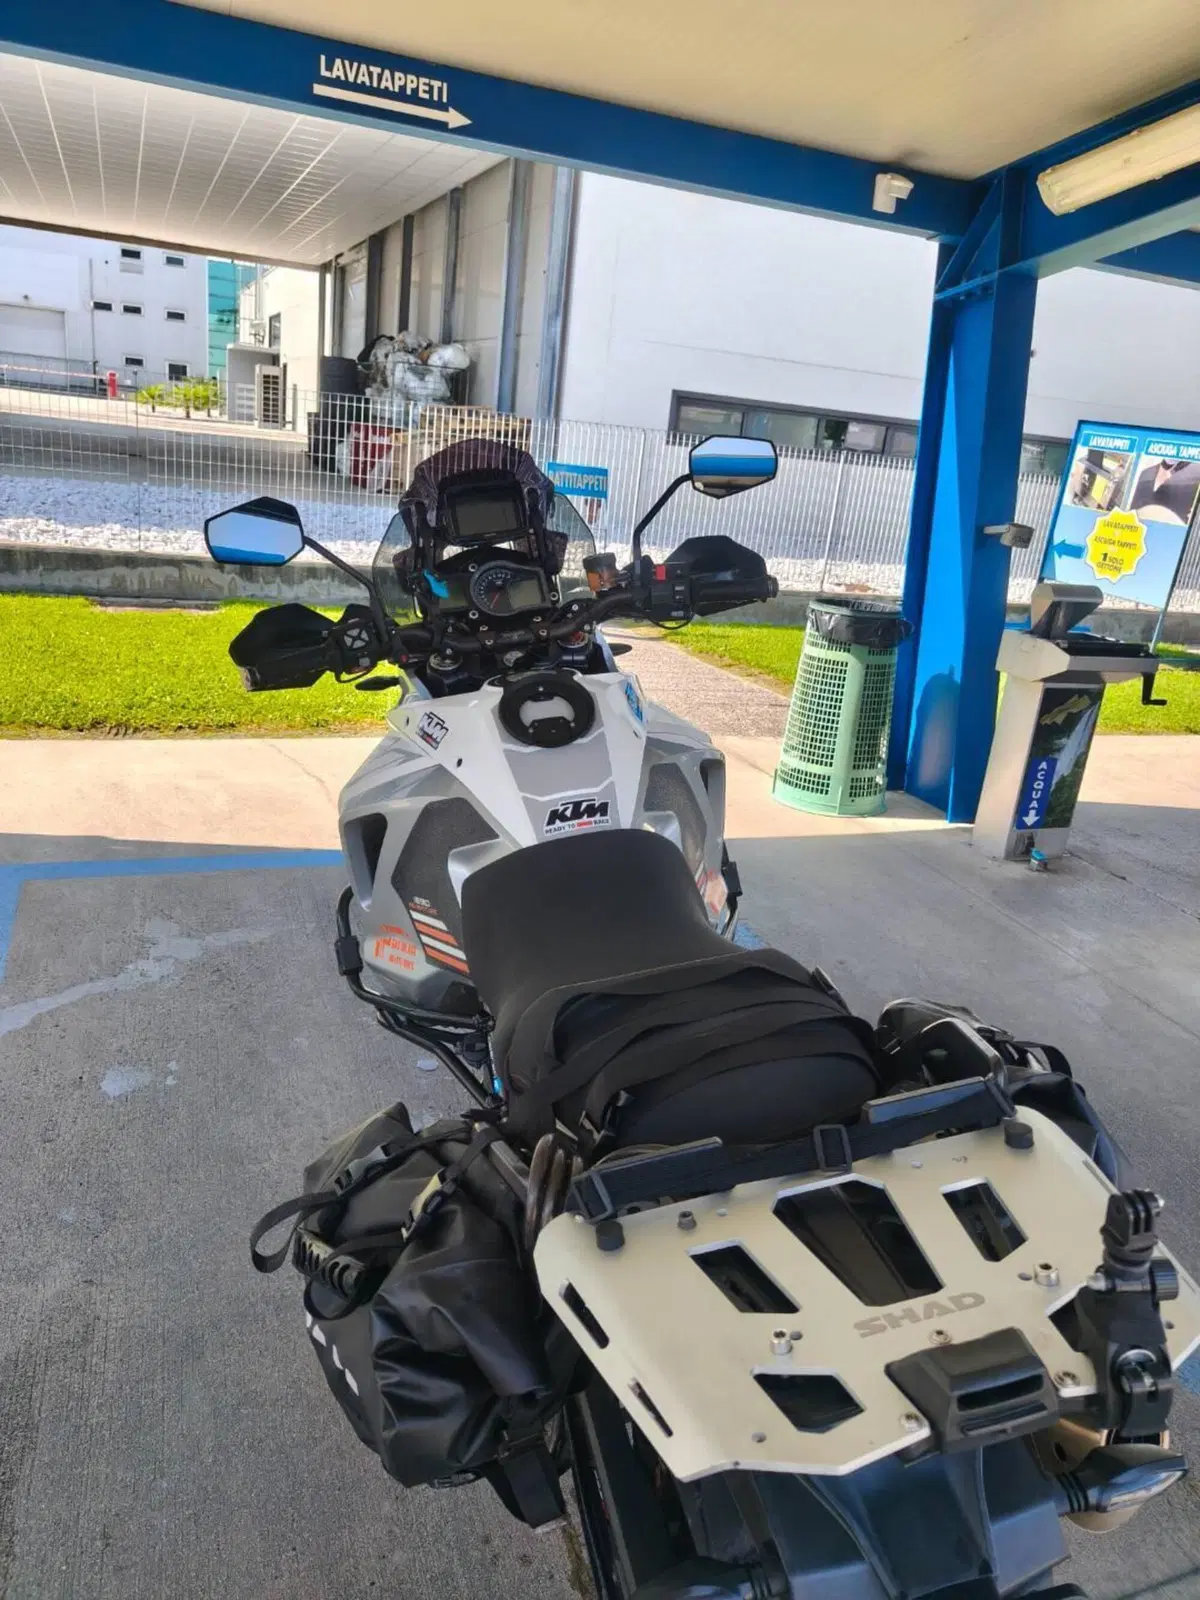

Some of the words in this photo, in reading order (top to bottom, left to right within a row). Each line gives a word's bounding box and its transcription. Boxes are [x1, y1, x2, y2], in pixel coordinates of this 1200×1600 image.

[319, 54, 448, 103] LAVATAPPETI
[1089, 435, 1130, 450] LAVATAPPETI
[1178, 445, 1200, 460] TAPPE
[1101, 552, 1109, 562] 1
[419, 711, 449, 744] KTM
[1028, 761, 1048, 809] ACQUA
[546, 798, 610, 826] KTM
[853, 1292, 985, 1339] SHAD
